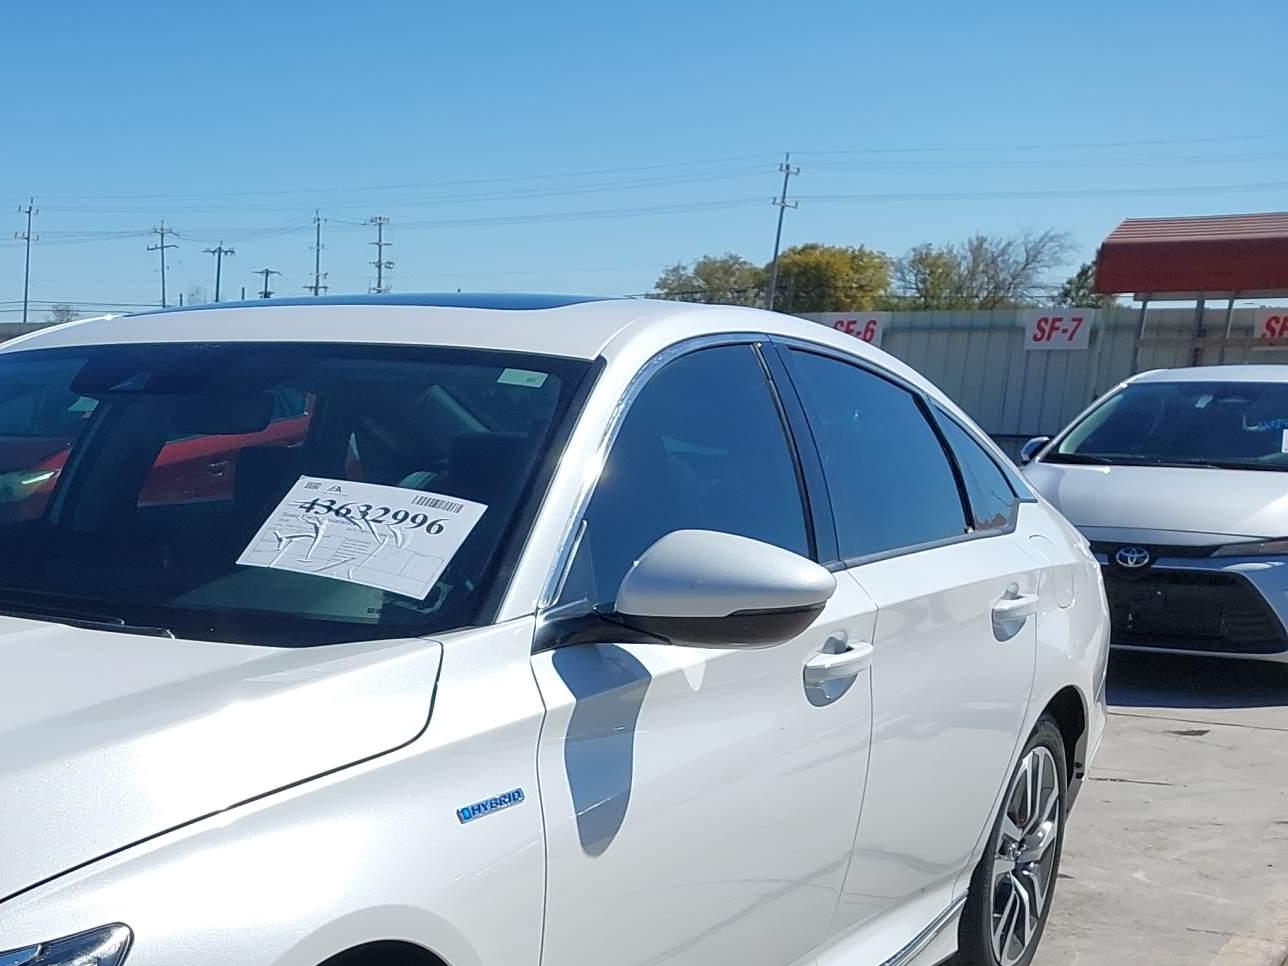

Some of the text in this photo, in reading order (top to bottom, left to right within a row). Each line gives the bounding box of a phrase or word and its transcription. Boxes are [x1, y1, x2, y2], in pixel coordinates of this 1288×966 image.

[1032, 316, 1083, 342] SF-7
[297, 498, 450, 535] 43632996
[471, 790, 521, 816] HYBRID
